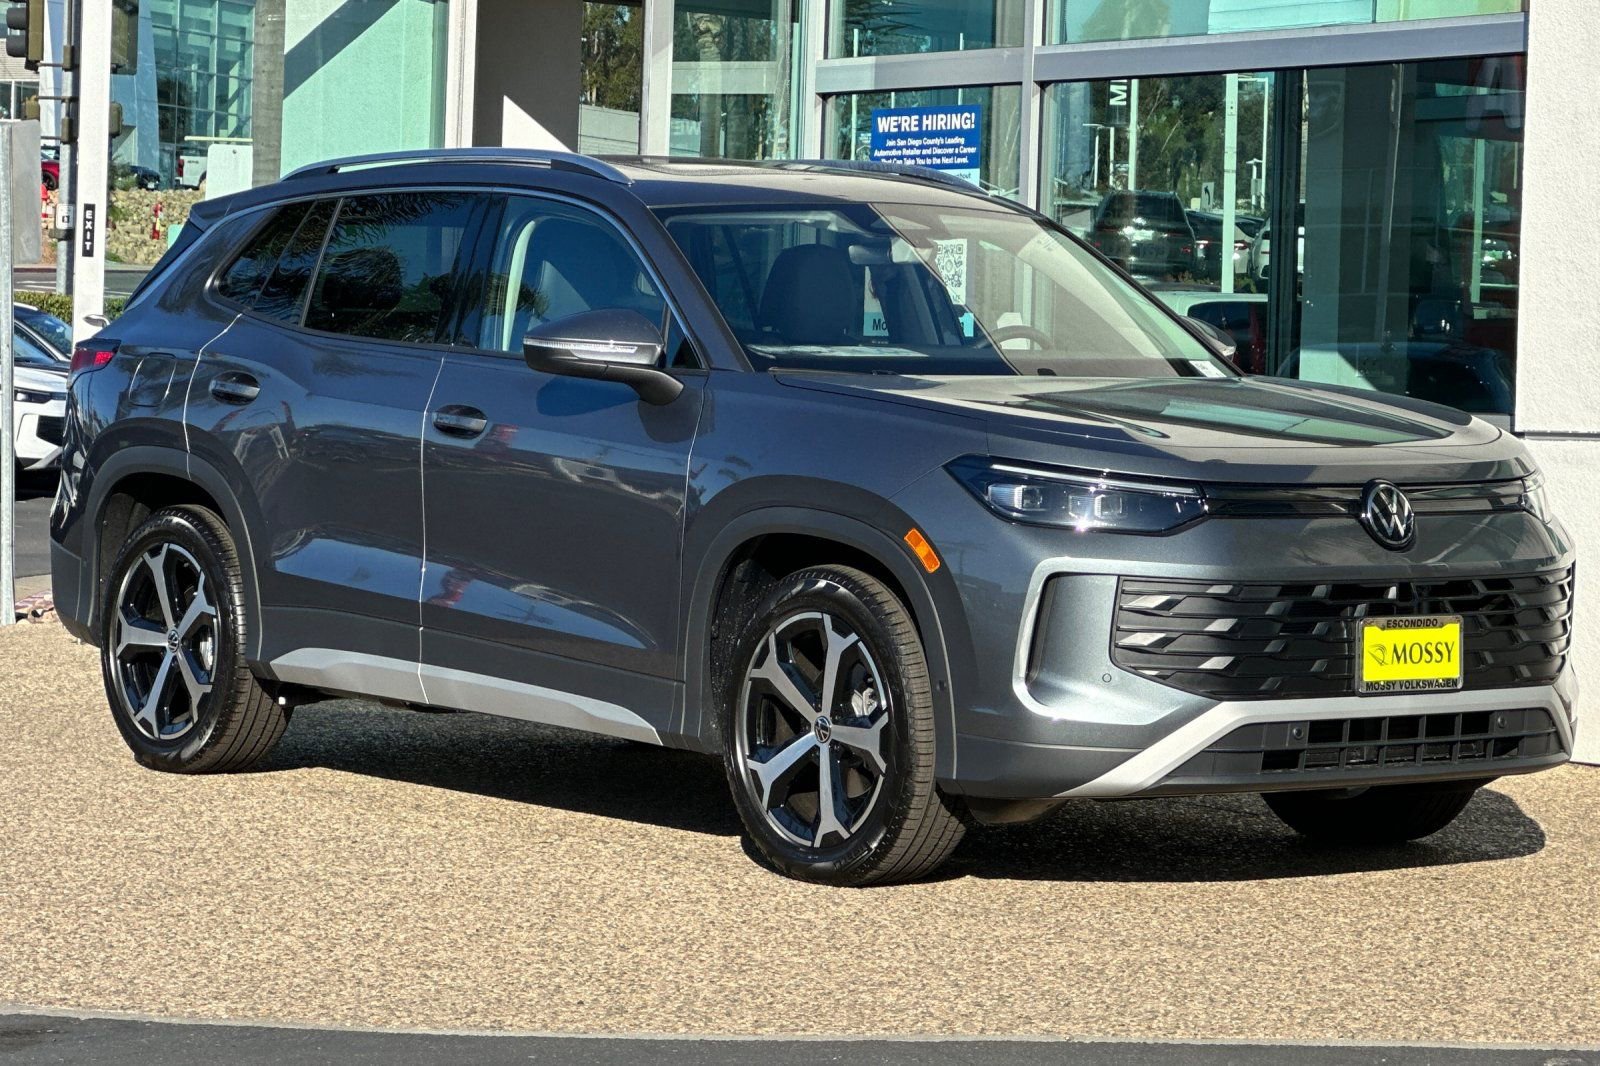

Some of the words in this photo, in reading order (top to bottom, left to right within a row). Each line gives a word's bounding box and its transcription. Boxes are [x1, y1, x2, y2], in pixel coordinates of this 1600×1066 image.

[877, 115, 919, 133] WE'RE
[922, 112, 976, 131] HIRING!
[886, 138, 896, 147] Join
[897, 138, 907, 146] San
[907, 137, 922, 147] Diego
[923, 136, 944, 145] County's
[945, 136, 965, 145] Leading
[874, 148, 902, 157] Automotive
[902, 147, 921, 156] Retailer
[932, 146, 954, 155] Discover
[960, 145, 976, 154] Career
[903, 157, 915, 165] Take
[916, 157, 925, 165] You
[926, 157, 931, 165] to
[932, 156, 941, 165] the
[942, 156, 953, 164] Next
[954, 155, 969, 164] Level.
[85, 210, 93, 250] EXIT
[1386, 618, 1438, 628] ESCONDIDO
[1391, 641, 1455, 665] MOSSY
[1365, 681, 1397, 691] MOSSY
[1399, 678, 1458, 689] VOLKSWAGEN
